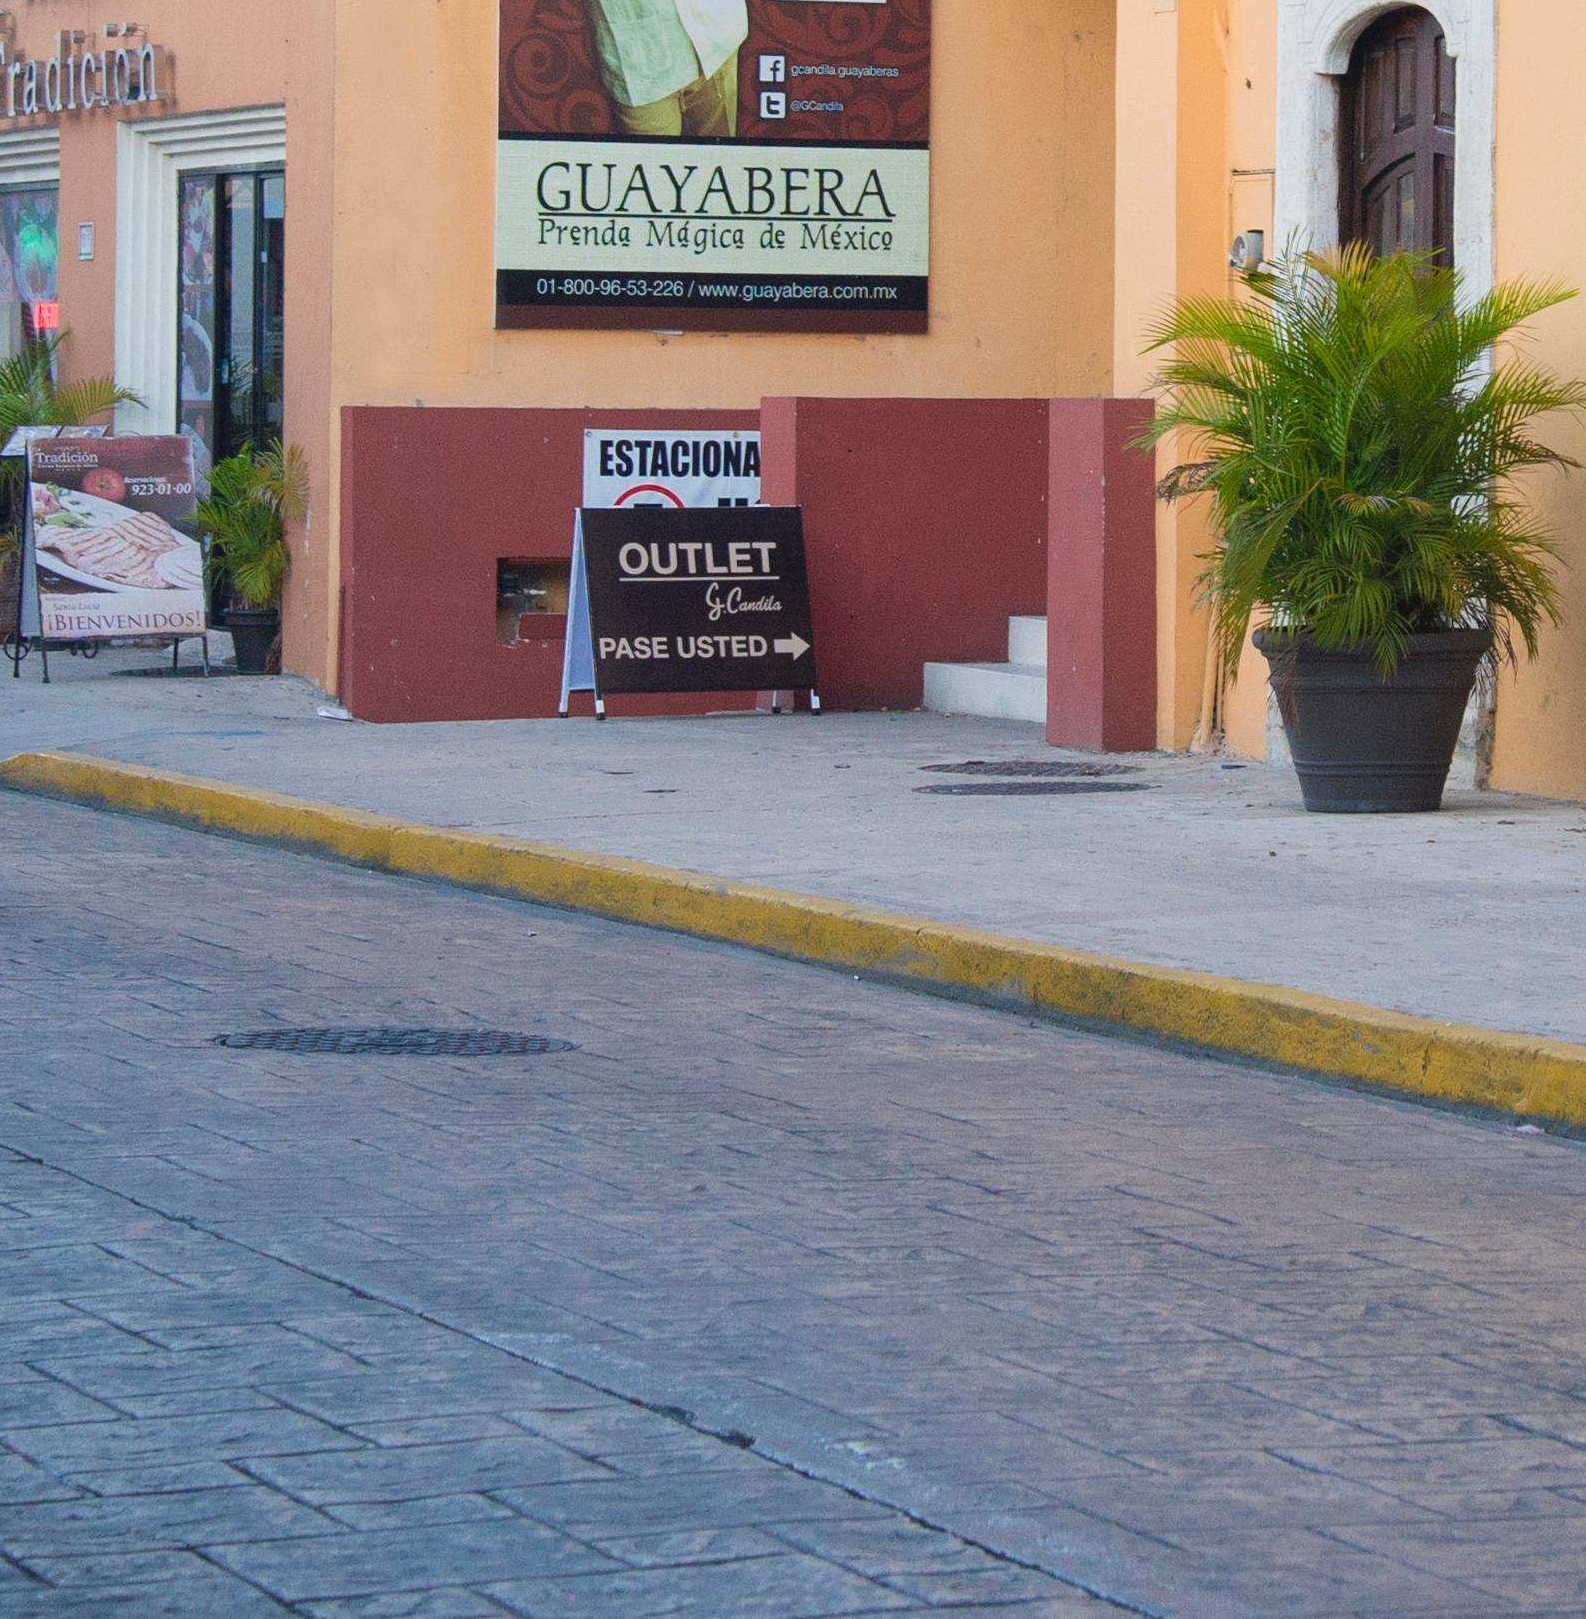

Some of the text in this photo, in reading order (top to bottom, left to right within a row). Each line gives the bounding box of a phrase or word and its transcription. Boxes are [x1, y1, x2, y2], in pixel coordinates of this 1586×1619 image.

[790, 63, 900, 79] gcandila.guayaberas
[536, 161, 897, 217] GUAYABERA
[538, 218, 893, 254] Prenda Mágica de México
[536, 278, 685, 297] 01-800-96-53-226
[699, 282, 898, 302] www.guayabera.com.mx
[35, 451, 99, 463] Tradición
[599, 439, 760, 478] ESTACIONA
[131, 482, 192, 496] 923-01-00
[618, 541, 777, 574] OUTLET
[599, 635, 768, 660] PASE USTED
